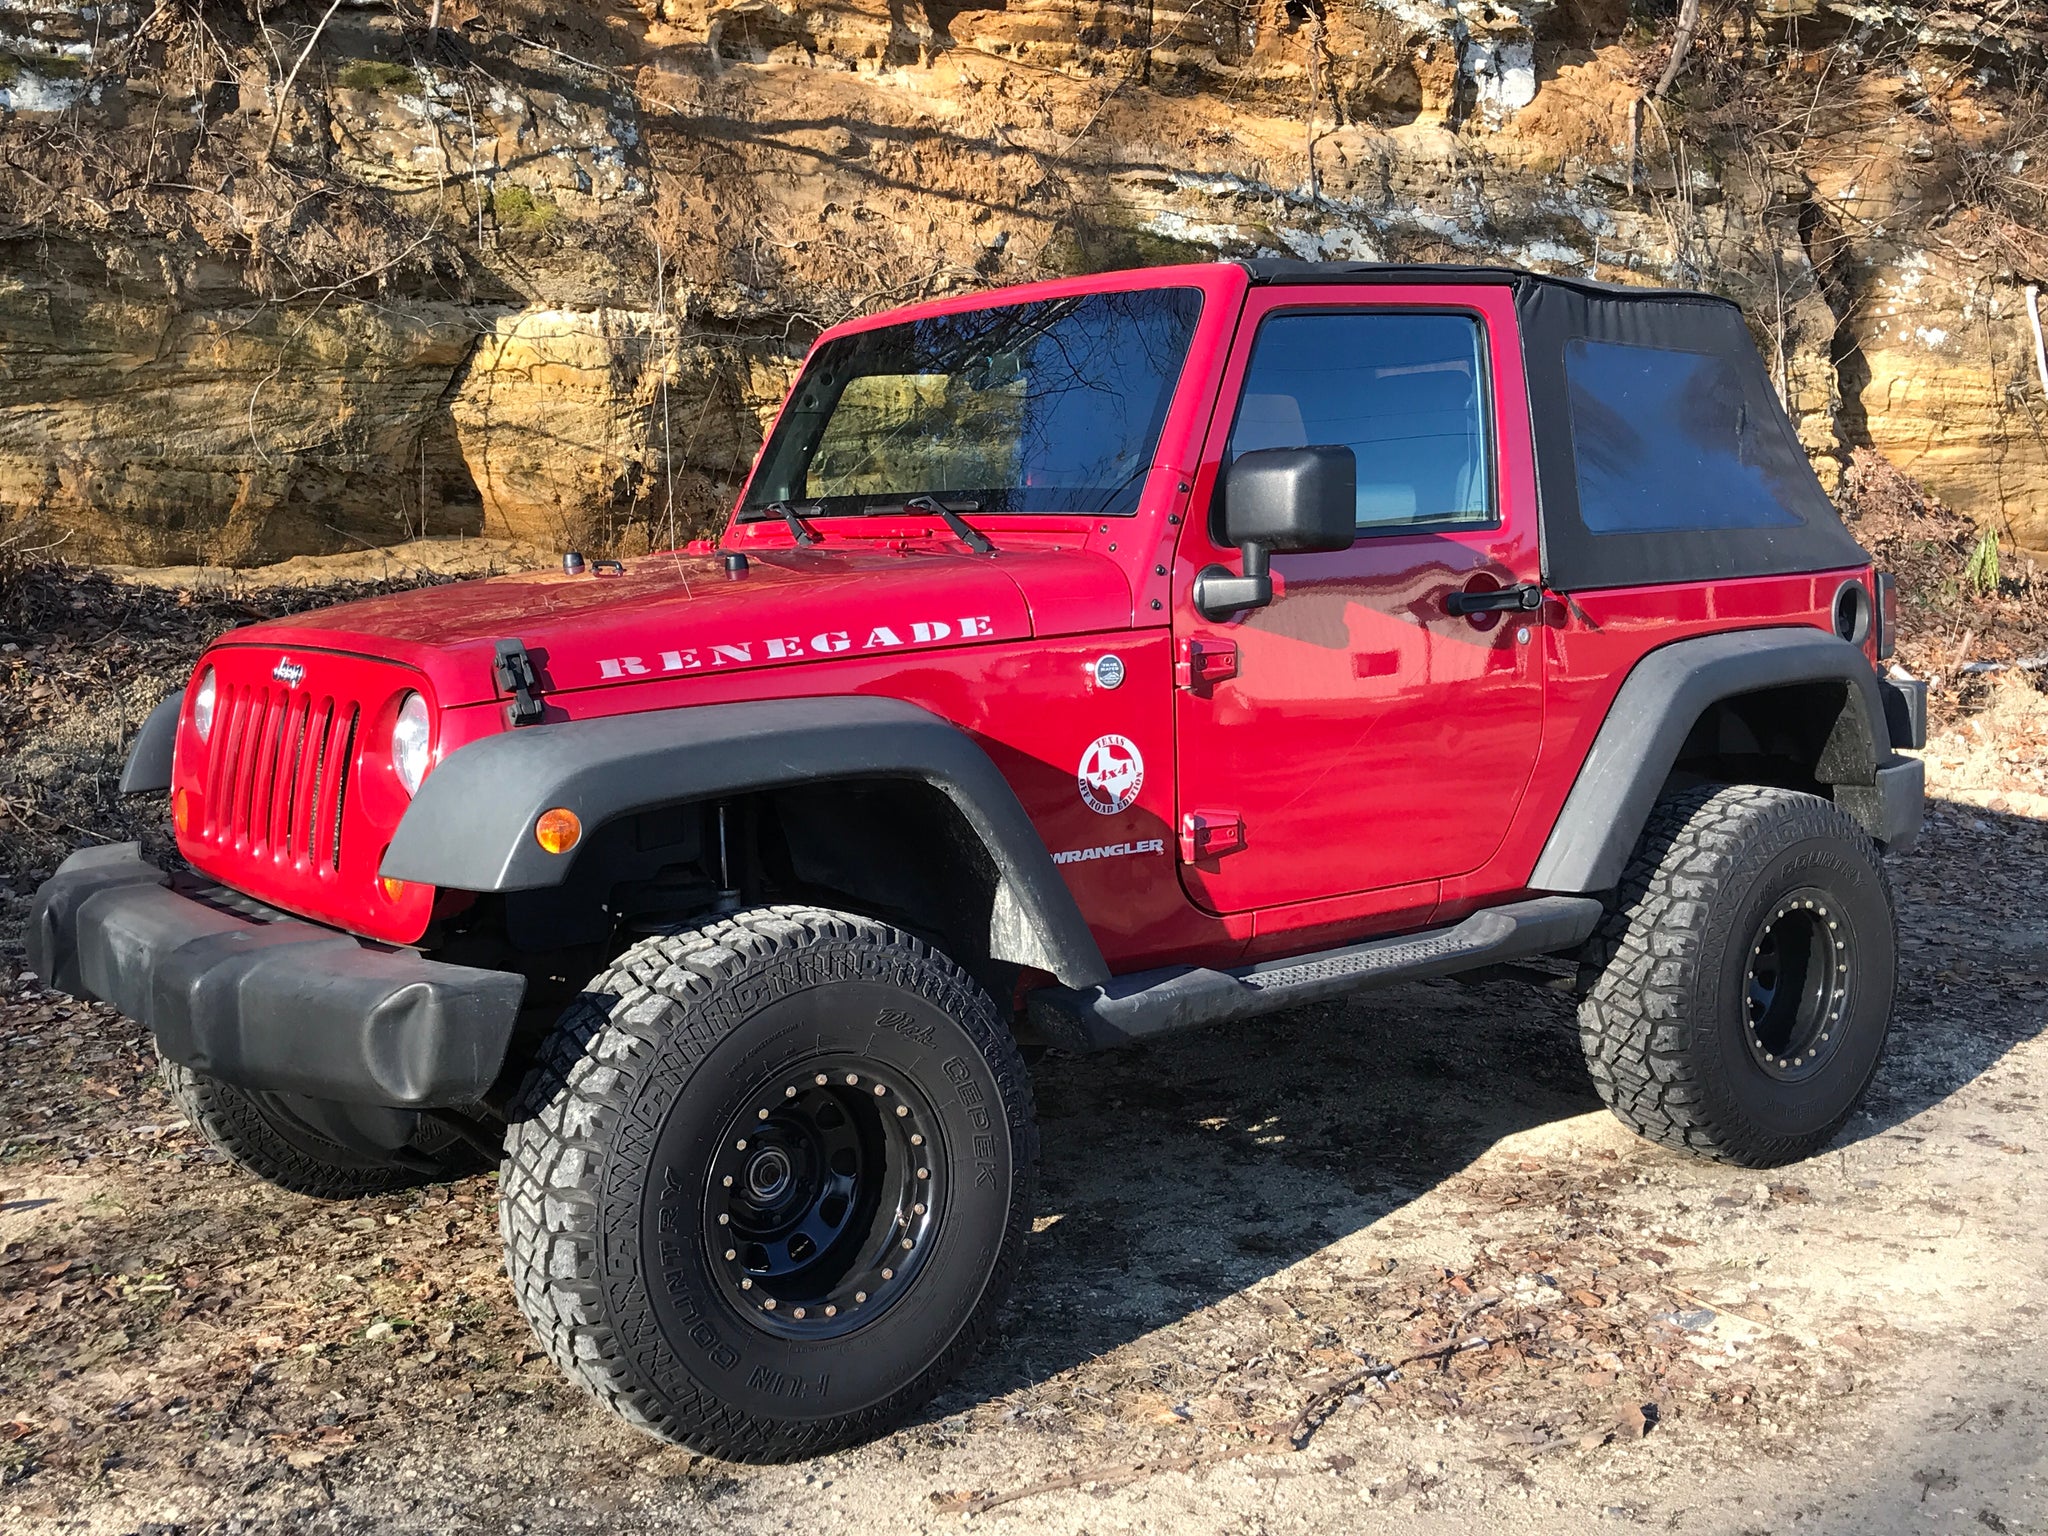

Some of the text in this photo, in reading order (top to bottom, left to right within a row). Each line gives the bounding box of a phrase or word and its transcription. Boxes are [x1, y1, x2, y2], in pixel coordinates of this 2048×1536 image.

[596, 615, 993, 679] RENEGADE
[1095, 736, 1126, 748] TEXAS
[1079, 771, 1143, 814] OFF ROAD EDITION
[1097, 762, 1128, 782] 4x4
[1780, 851, 1866, 887] COUNTRY
[874, 1007, 938, 1050] Dick
[940, 1055, 998, 1191] CEPEK
[657, 1164, 742, 1372] COUNTRY
